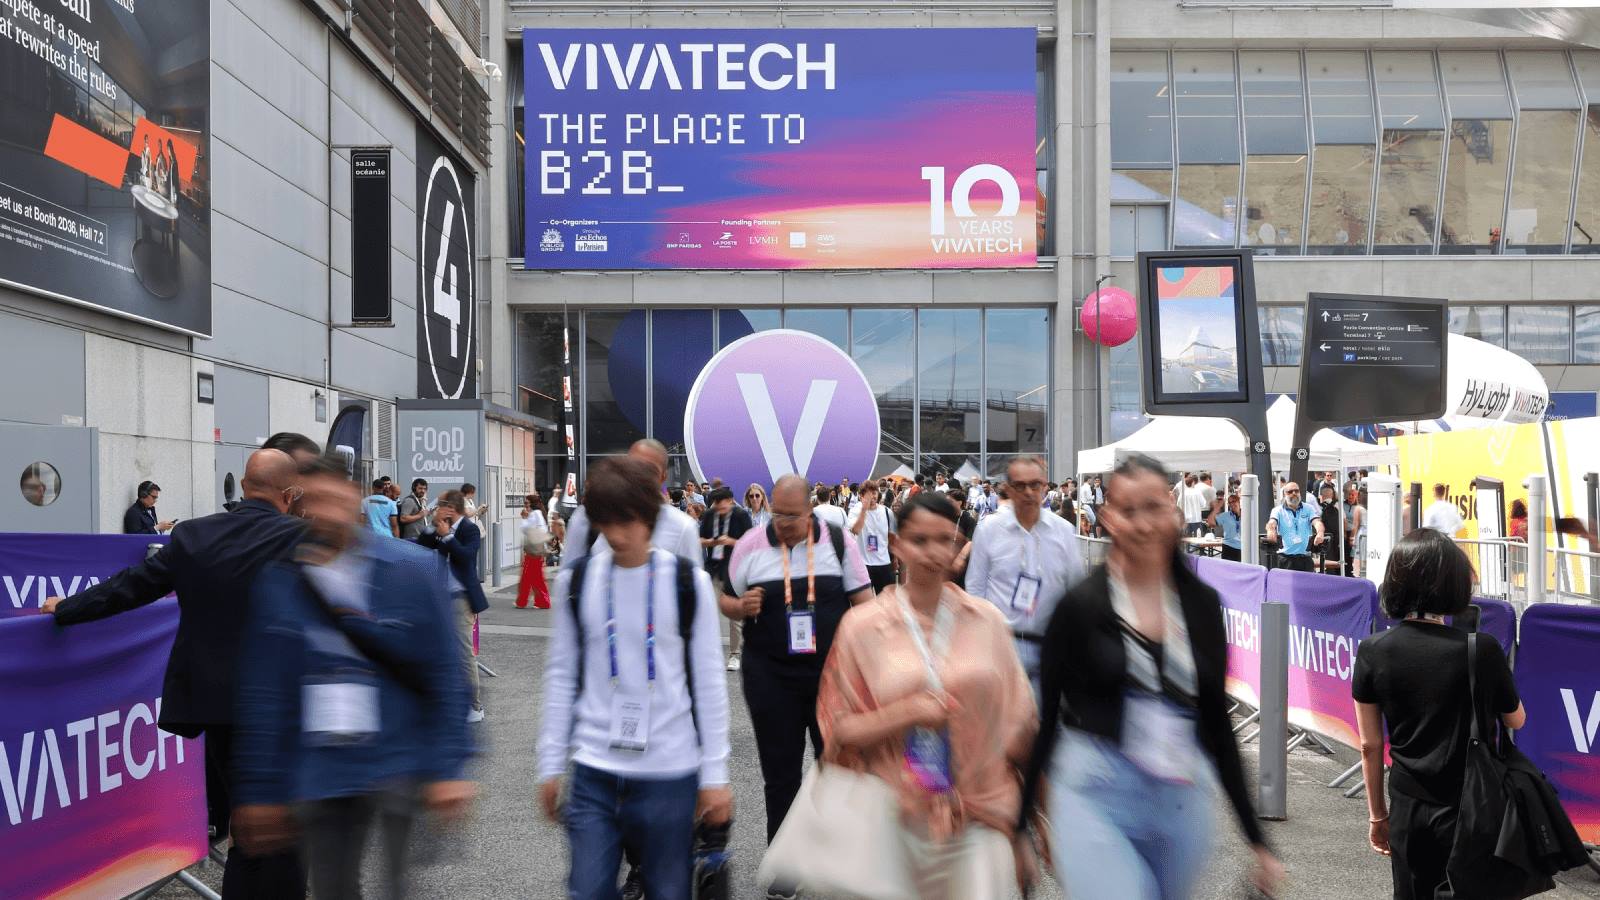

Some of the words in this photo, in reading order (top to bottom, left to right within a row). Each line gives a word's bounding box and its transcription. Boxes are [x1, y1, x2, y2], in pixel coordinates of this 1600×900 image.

[43, 13, 56, 35] at
[58, 22, 65, 41] a
[67, 28, 101, 64] speed
[15, 26, 67, 71] rewrites
[69, 55, 88, 84] the
[89, 72, 117, 100] rules
[538, 43, 836, 91] VIVATECH
[539, 113, 607, 144] THE
[626, 113, 745, 144] PLACE
[761, 113, 806, 144] TO
[355, 168, 386, 176] océanie
[921, 163, 1021, 236] 10
[12, 200, 23, 215] us
[24, 205, 33, 219] at
[34, 206, 57, 228] Booth
[79, 223, 93, 241] Hall
[93, 229, 104, 245] 7.2
[549, 219, 599, 227] Co-Organizers
[721, 219, 752, 227] Founding
[959, 220, 1014, 235] YEARS
[575, 233, 587, 241] Les
[588, 233, 608, 241] Echos
[749, 236, 778, 245] LVMH
[931, 237, 1023, 254] VIVATECH
[433, 200, 460, 358] 4
[1361, 312, 1369, 321] 7
[1460, 379, 1511, 418] HyLight
[411, 426, 465, 456] FOOD
[1025, 428, 1037, 442] 7
[411, 452, 465, 473] Court
